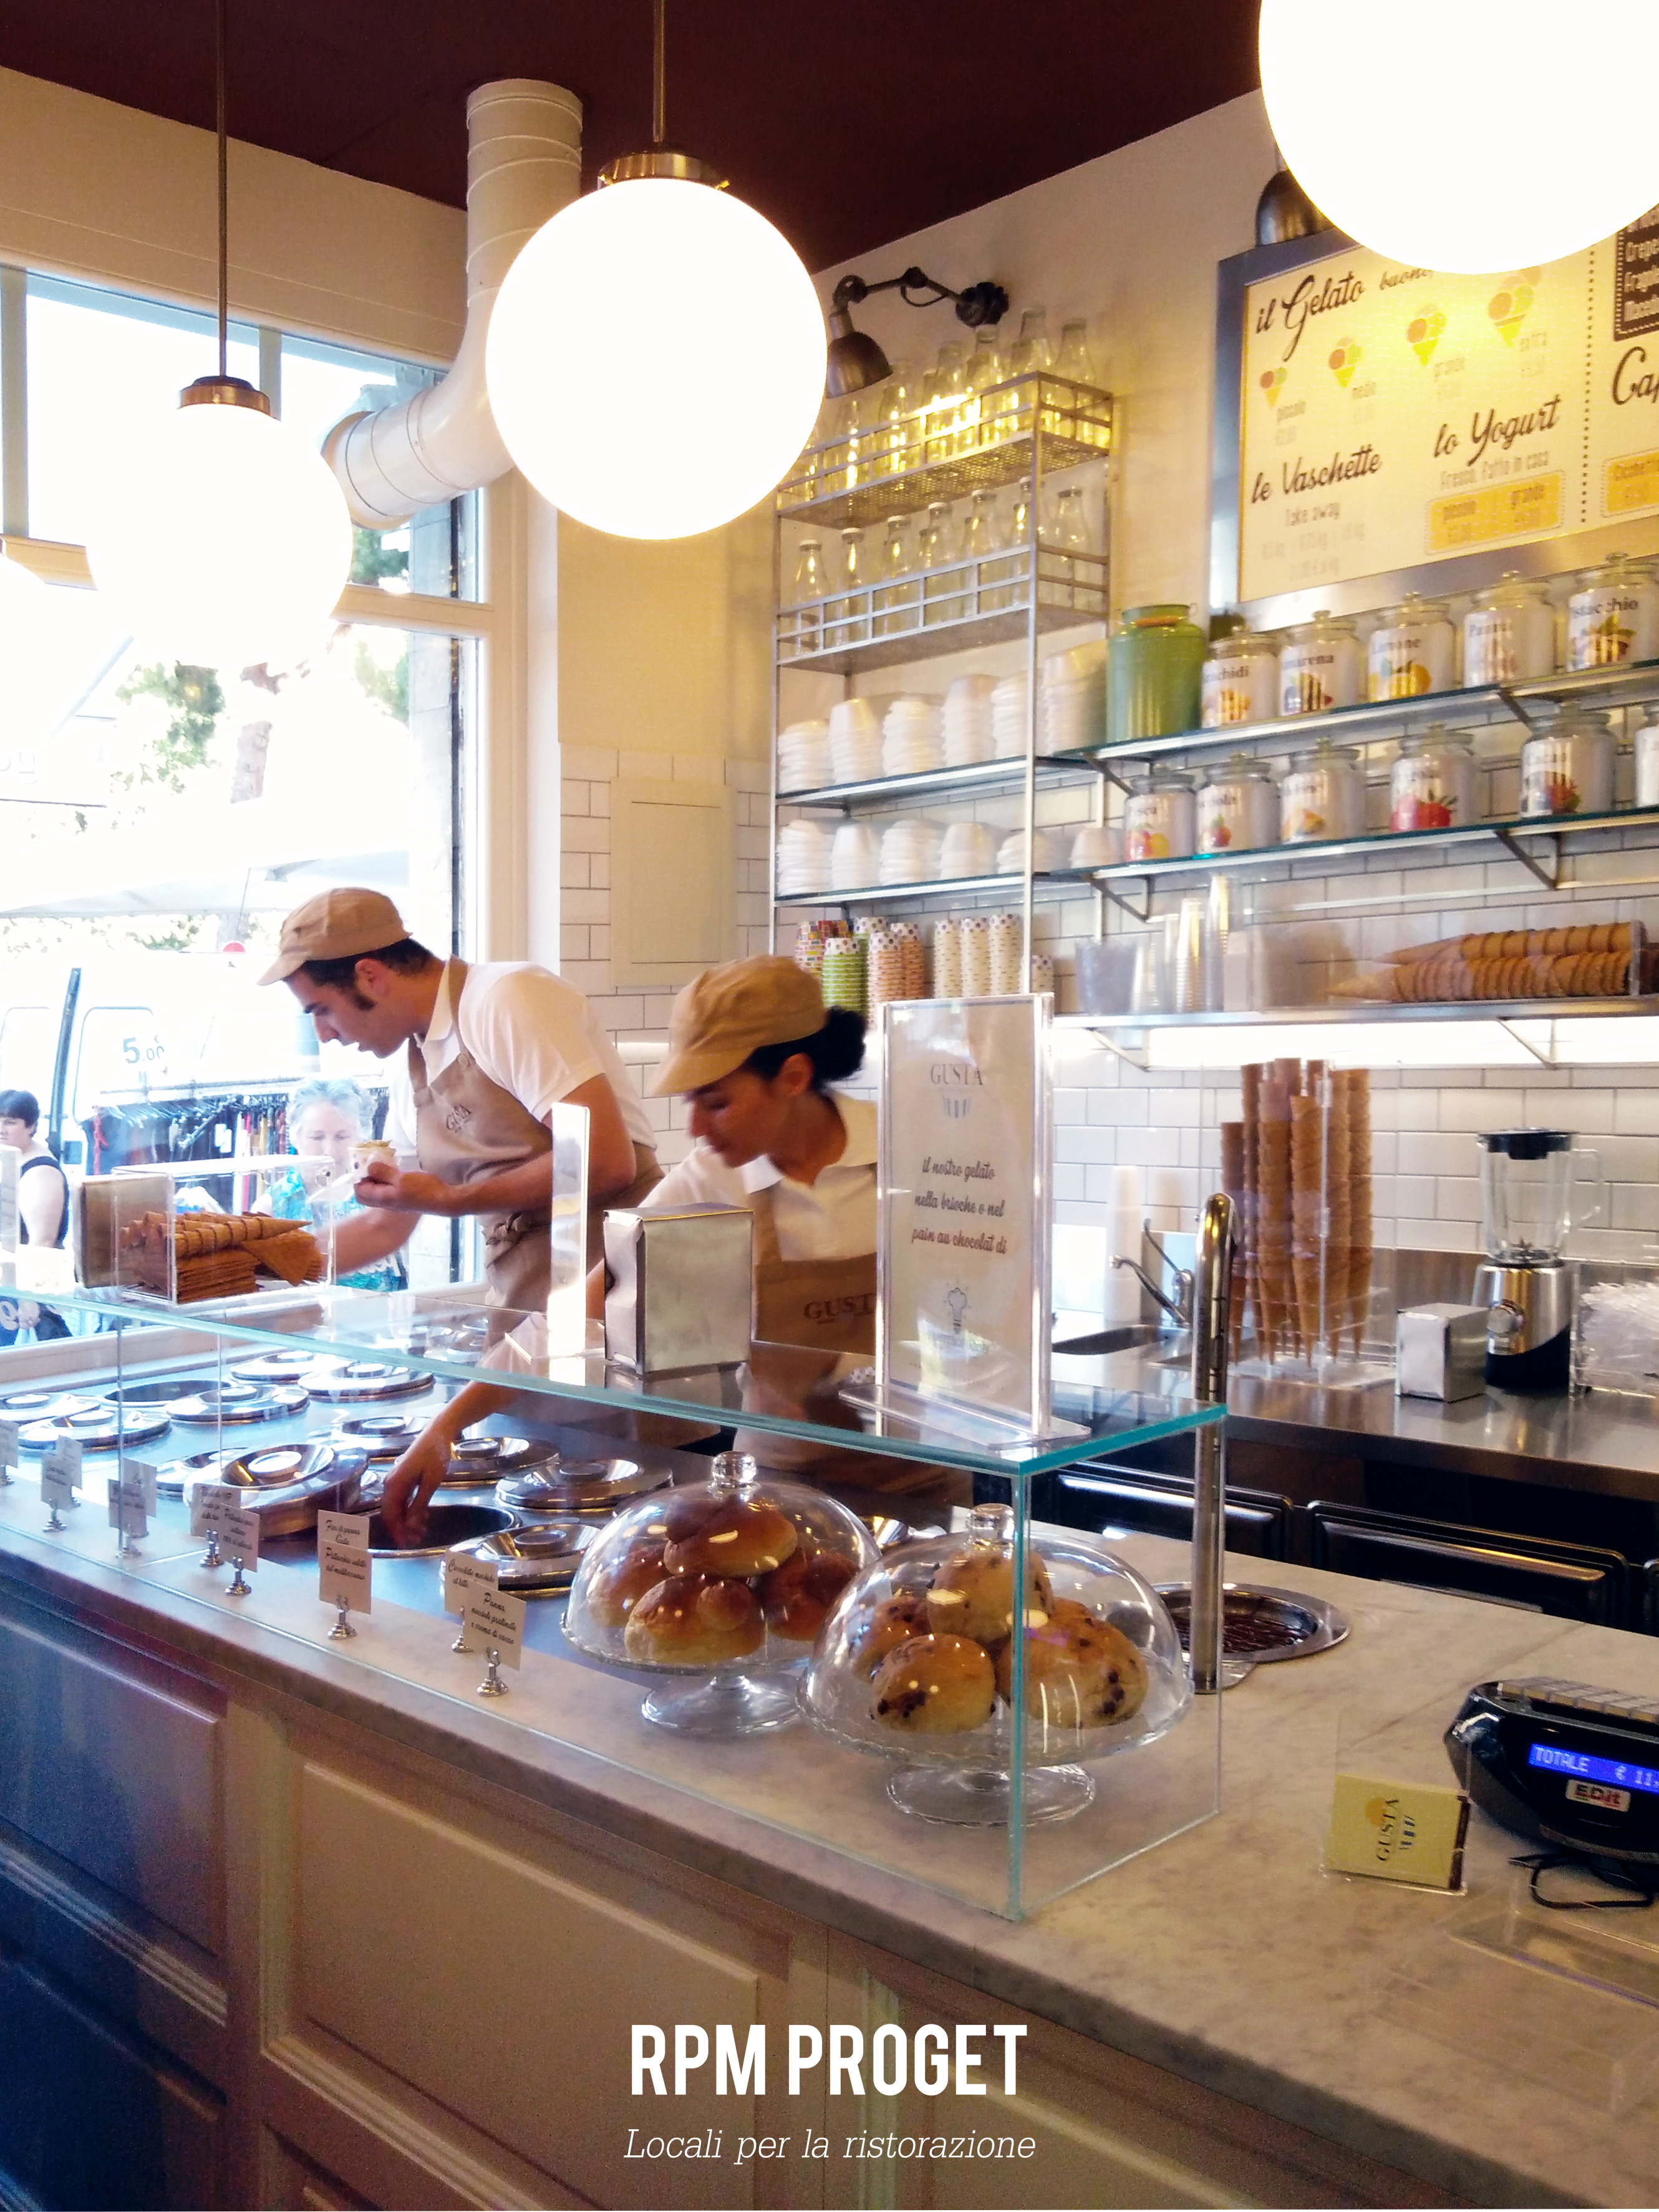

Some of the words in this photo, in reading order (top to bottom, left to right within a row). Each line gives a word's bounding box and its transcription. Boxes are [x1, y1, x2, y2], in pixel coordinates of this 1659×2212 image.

[1255, 297, 1277, 334] il
[1282, 271, 1366, 362] Gelato
[1434, 423, 1460, 458] lo
[1467, 394, 1561, 467] Yogurt
[1251, 471, 1272, 504] le
[1282, 443, 1383, 495] Vaschette
[930, 1061, 984, 1086] GUSTA
[922, 1156, 931, 1173] il
[932, 1159, 962, 1176] nostro
[964, 1161, 995, 1182] gelato
[915, 1191, 938, 1209] nella
[941, 1193, 975, 1213] brioche
[979, 1204, 984, 1214] o
[988, 1199, 1005, 1217] nel
[912, 1228, 935, 1244] pain
[937, 1232, 950, 1244] au
[952, 1230, 994, 1252] chocolat
[996, 1236, 1007, 1254] di
[803, 1293, 873, 1320] GUST
[1536, 1747, 1590, 1772] TOTALE
[1376, 1799, 1399, 1861] GUSTA
